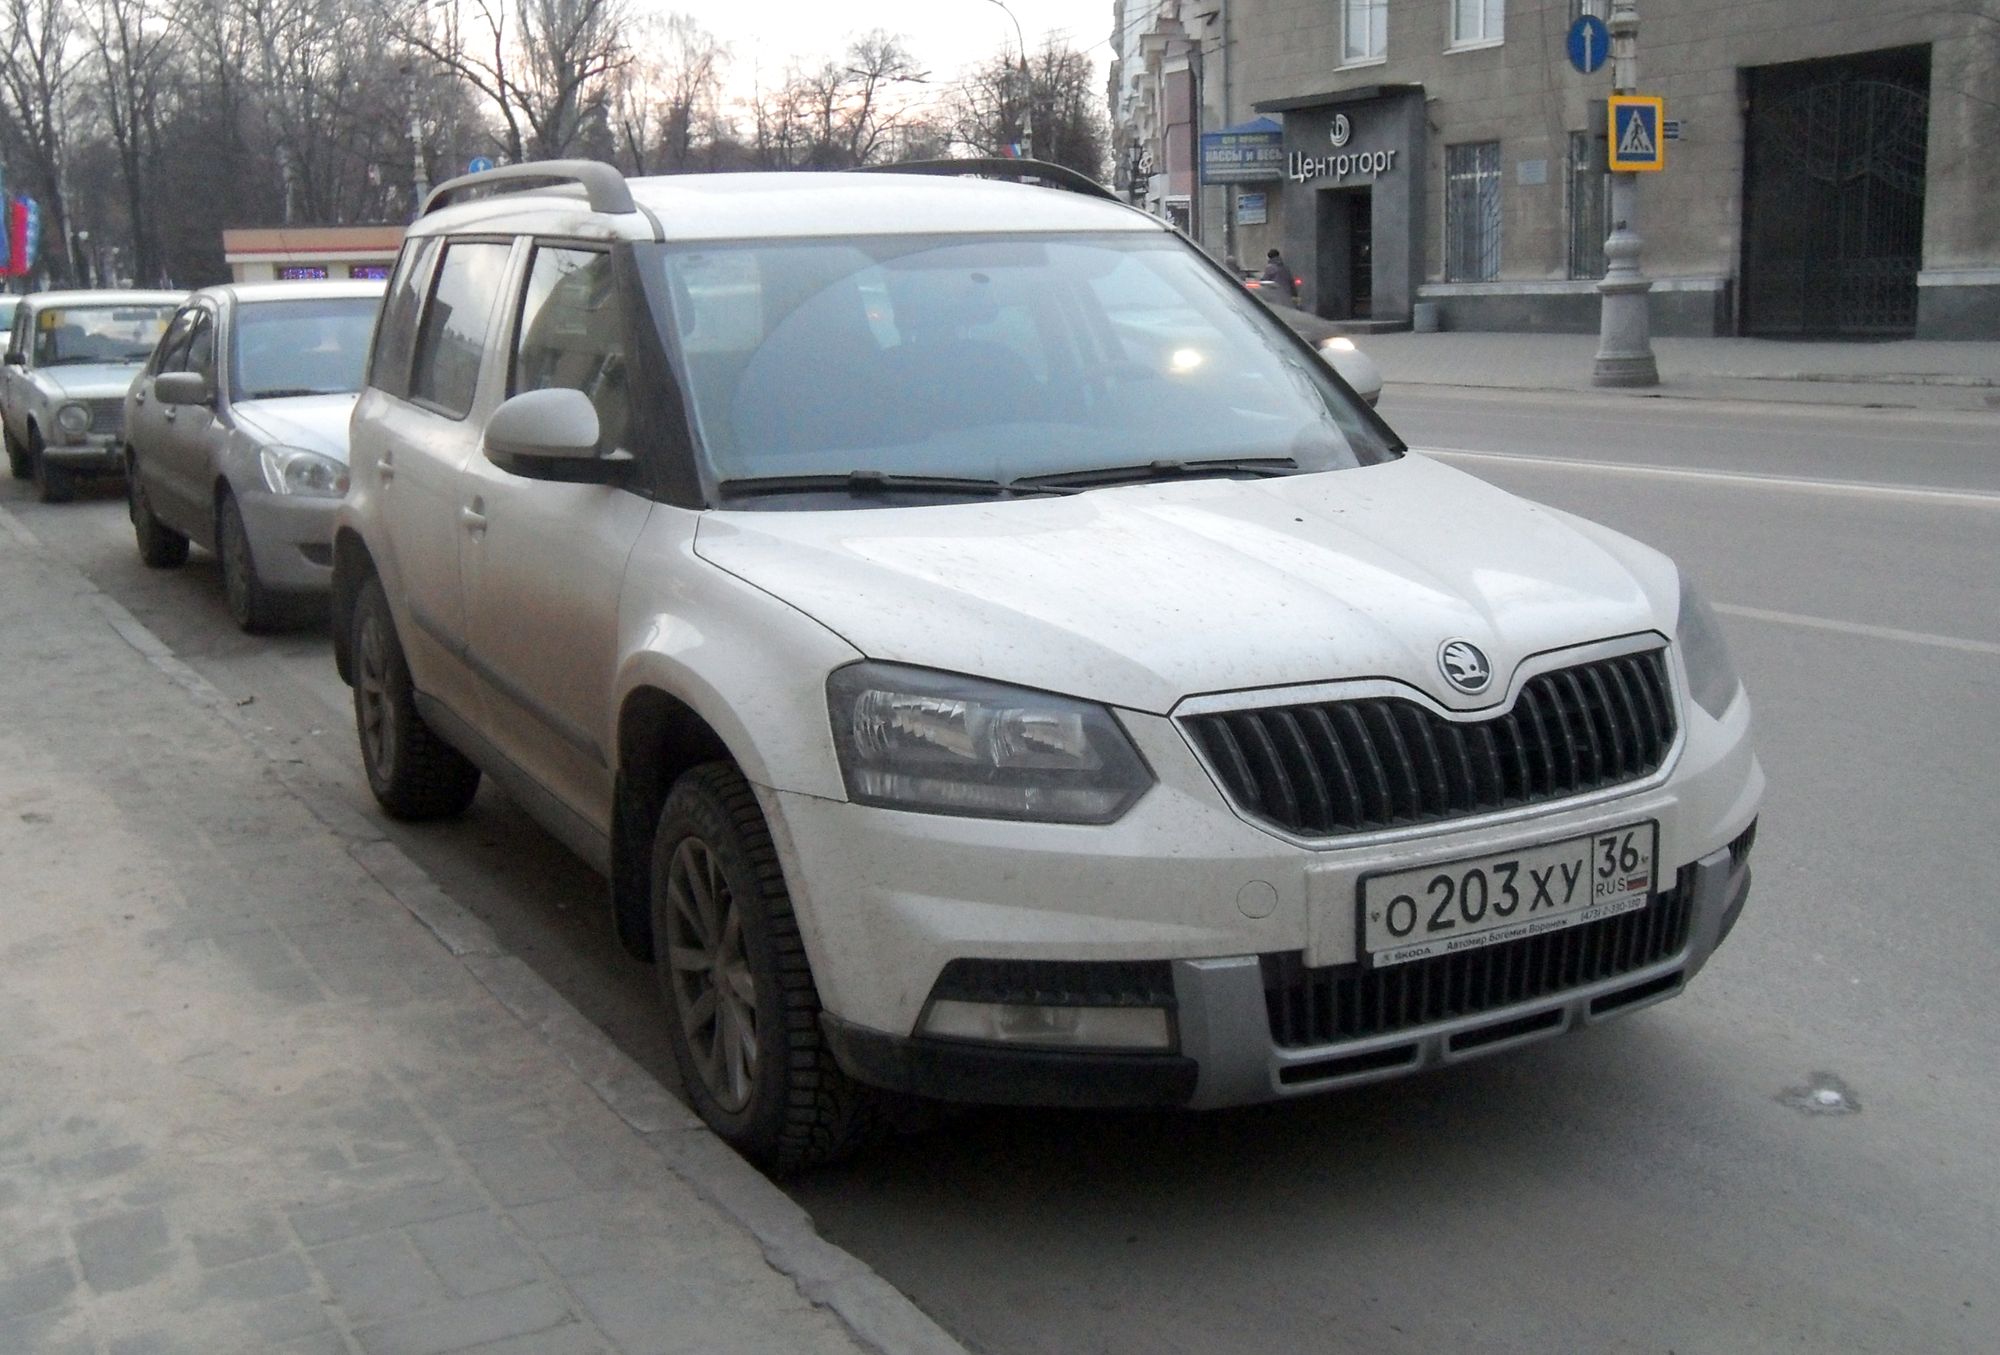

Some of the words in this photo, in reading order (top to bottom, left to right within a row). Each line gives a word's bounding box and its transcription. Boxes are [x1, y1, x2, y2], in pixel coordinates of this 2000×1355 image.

[1289, 150, 1396, 182] Центрторг
[1598, 831, 1640, 879] 36
[1596, 880, 1627, 898] RUS
